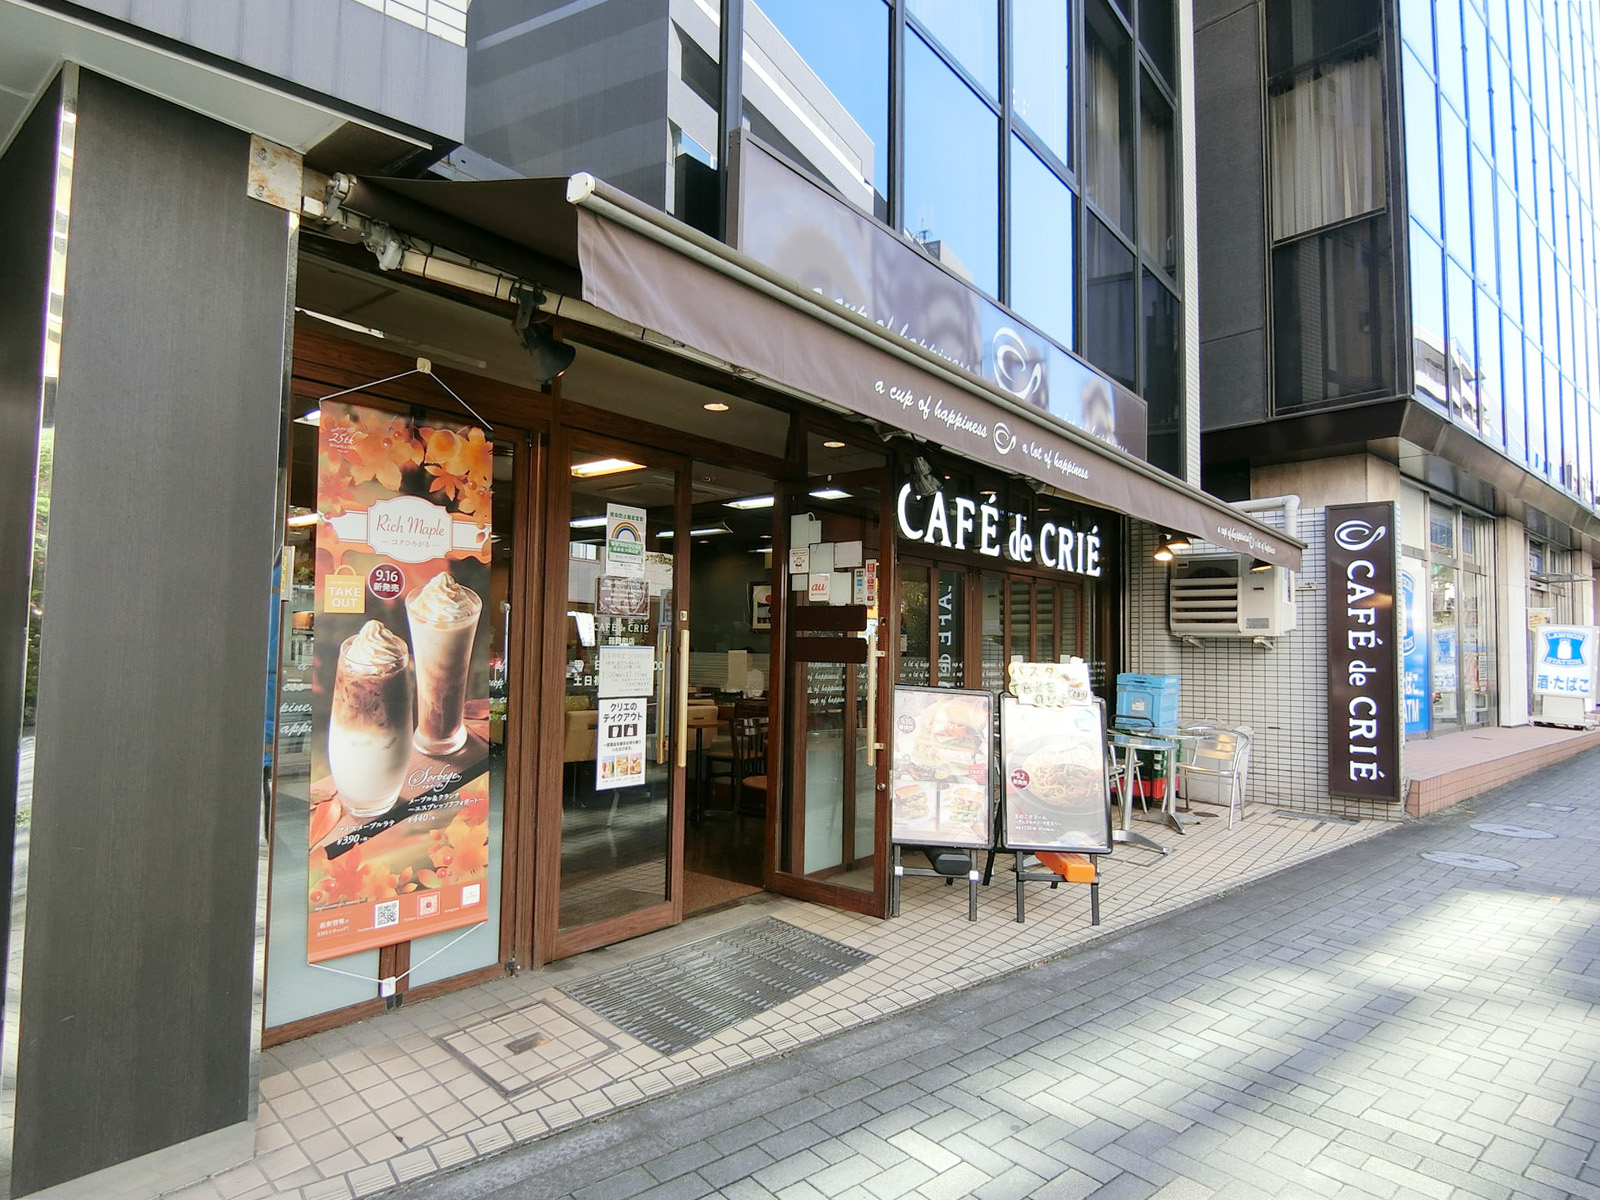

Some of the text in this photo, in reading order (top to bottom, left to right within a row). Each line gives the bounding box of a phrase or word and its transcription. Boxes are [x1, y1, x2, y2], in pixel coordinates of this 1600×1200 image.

[874, 380, 988, 439] a cup of happiness
[1029, 441, 1043, 461] lot
[1043, 451, 1053, 469] of
[1053, 451, 1089, 480] happiness
[376, 513, 445, 539] Rich Maple
[897, 482, 1102, 577] CAFÉ de CRIÉ
[375, 569, 398, 582] 9.16
[328, 586, 362, 597] TAKE
[373, 582, 400, 593] 新発売
[811, 583, 827, 591] au
[331, 597, 357, 608] OUT
[1011, 665, 1054, 678] パスタ
[1345, 559, 1385, 781] CAFÉ de CRIÉ
[1537, 674, 1589, 693] 酒・たばこ
[610, 702, 638, 712] クリエの
[603, 712, 643, 723] テイクアウト
